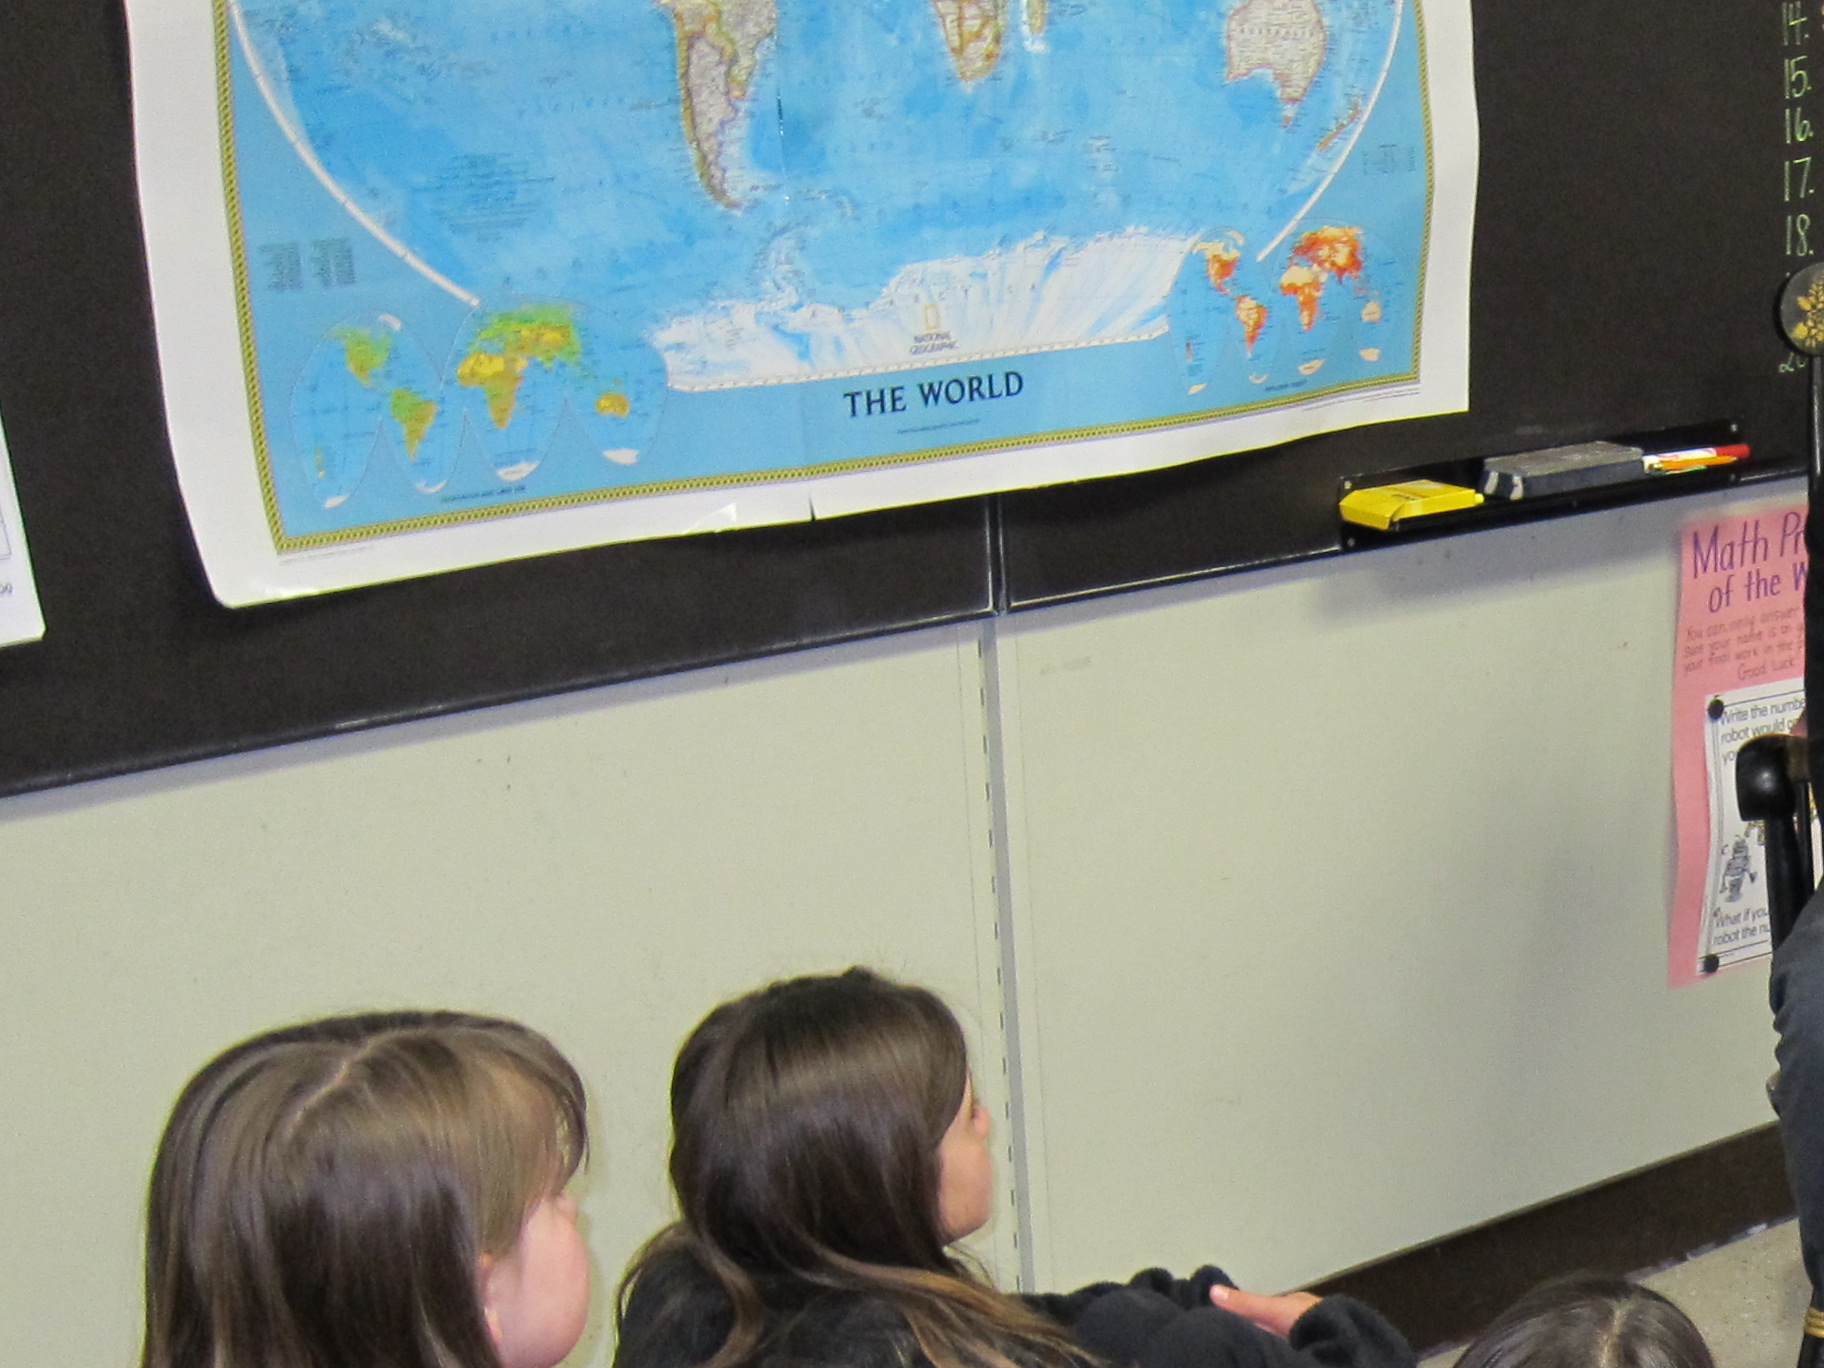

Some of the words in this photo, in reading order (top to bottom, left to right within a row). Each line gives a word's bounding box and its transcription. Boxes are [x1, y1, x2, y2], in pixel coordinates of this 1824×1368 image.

[1784, 55, 1812, 99] 15.
[1784, 106, 1814, 144] 16.
[1784, 156, 1815, 202] 17.
[1786, 213, 1815, 257] 18.
[843, 386, 907, 418] THE
[917, 370, 1025, 409] WORLD
[1693, 518, 1769, 580] Math
[1709, 574, 1735, 613] of
[1744, 567, 1781, 601] the
[1750, 703, 1769, 720] the
[1721, 726, 1750, 745] robot
[1713, 928, 1740, 946] robot
[1741, 925, 1757, 939] the
[1714, 910, 1742, 928] What
